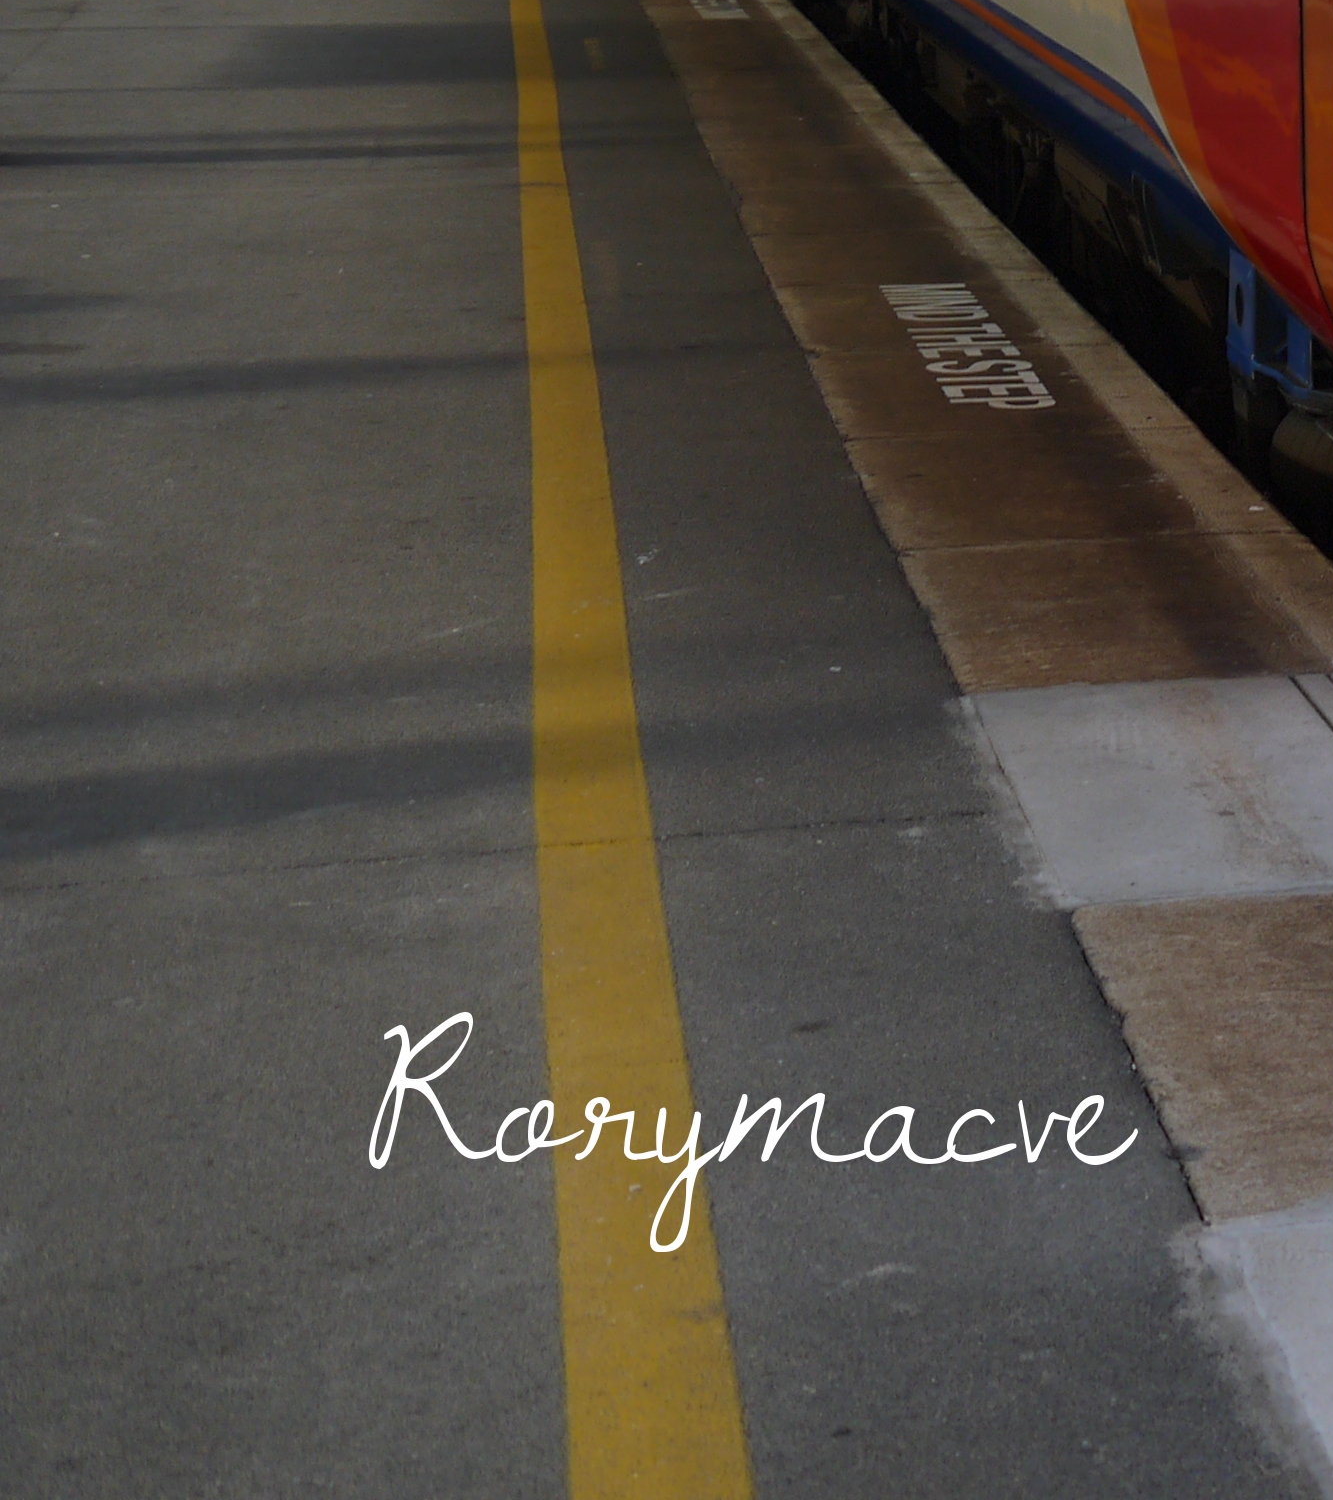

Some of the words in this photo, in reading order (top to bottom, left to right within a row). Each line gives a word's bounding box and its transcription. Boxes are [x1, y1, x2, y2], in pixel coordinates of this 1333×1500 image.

[879, 283, 989, 321] MIND
[907, 323, 1020, 358] THE
[926, 359, 1056, 409] STEP
